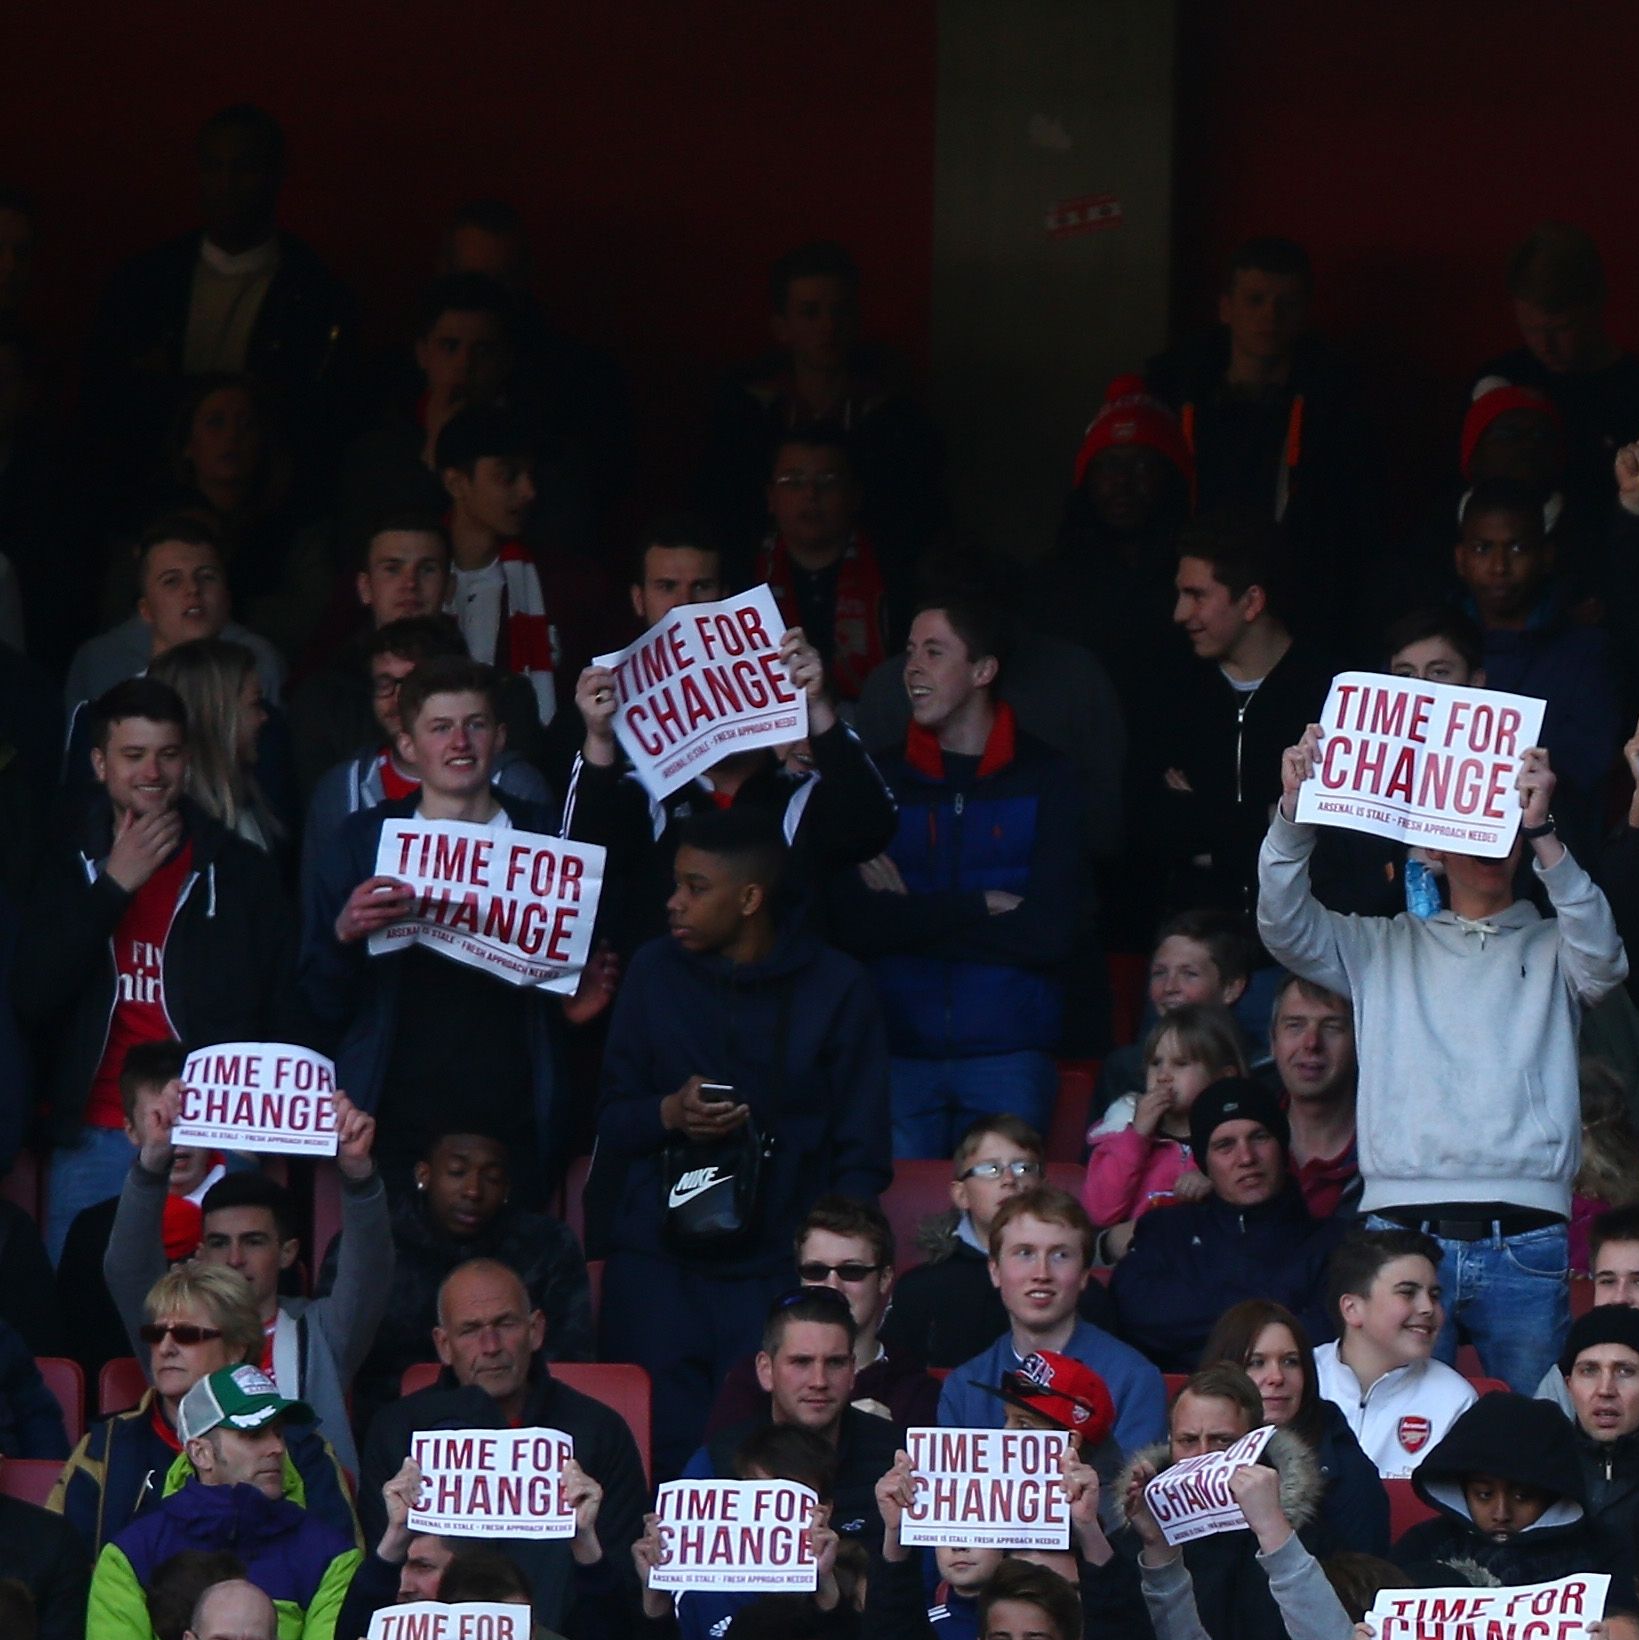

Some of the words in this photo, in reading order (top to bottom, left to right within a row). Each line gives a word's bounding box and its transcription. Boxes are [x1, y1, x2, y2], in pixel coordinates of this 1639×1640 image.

[613, 622, 692, 700] TIME
[693, 606, 770, 662] FOR
[625, 651, 795, 752] CHANGE
[1332, 687, 1434, 746] TIME
[1447, 705, 1520, 755] FOR
[1324, 733, 1514, 817] CHANGE
[393, 835, 493, 889] TIME
[508, 848, 584, 904] FOR
[419, 886, 580, 962] HANGE
[186, 1057, 260, 1088] TIME
[180, 1088, 336, 1133] CHANGE
[676, 1166, 720, 1190] NIKE
[416, 1439, 496, 1470] TIME
[913, 1435, 986, 1473] TIME
[1005, 1437, 1067, 1475] FOR
[660, 1489, 740, 1522] TIME
[902, 1479, 1068, 1523] CHANGE
